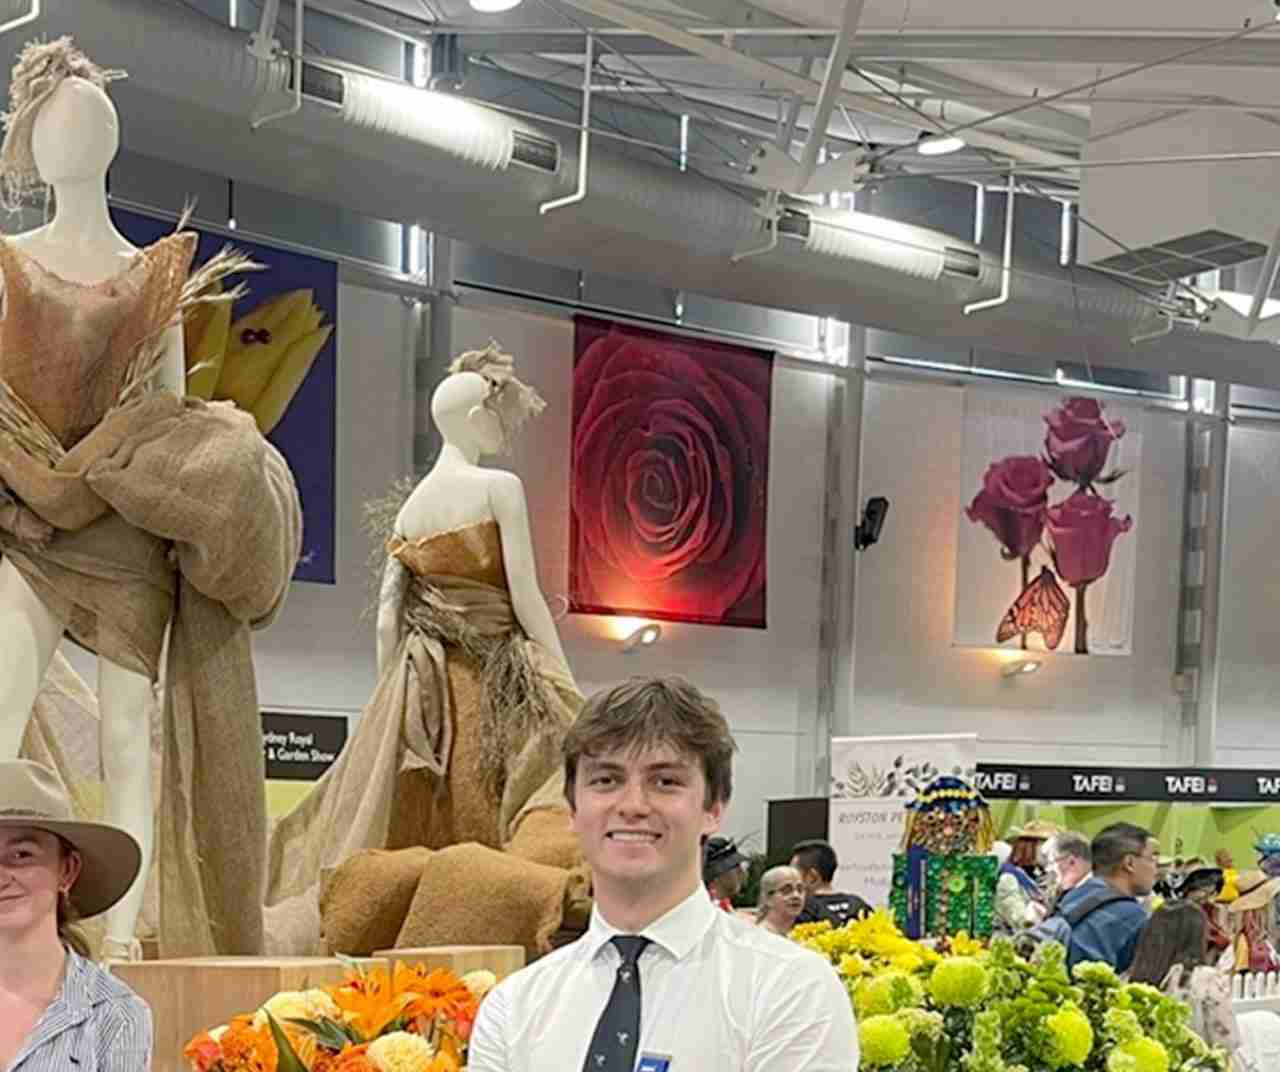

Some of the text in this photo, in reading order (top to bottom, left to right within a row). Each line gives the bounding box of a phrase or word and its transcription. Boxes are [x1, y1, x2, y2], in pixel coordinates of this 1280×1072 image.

[288, 731, 313, 749] Royal
[277, 747, 309, 761] Garden
[310, 748, 335, 762] Show
[1072, 774, 1113, 792] TAFE
[1165, 775, 1205, 793] TAFE
[1257, 777, 1280, 794] TAF
